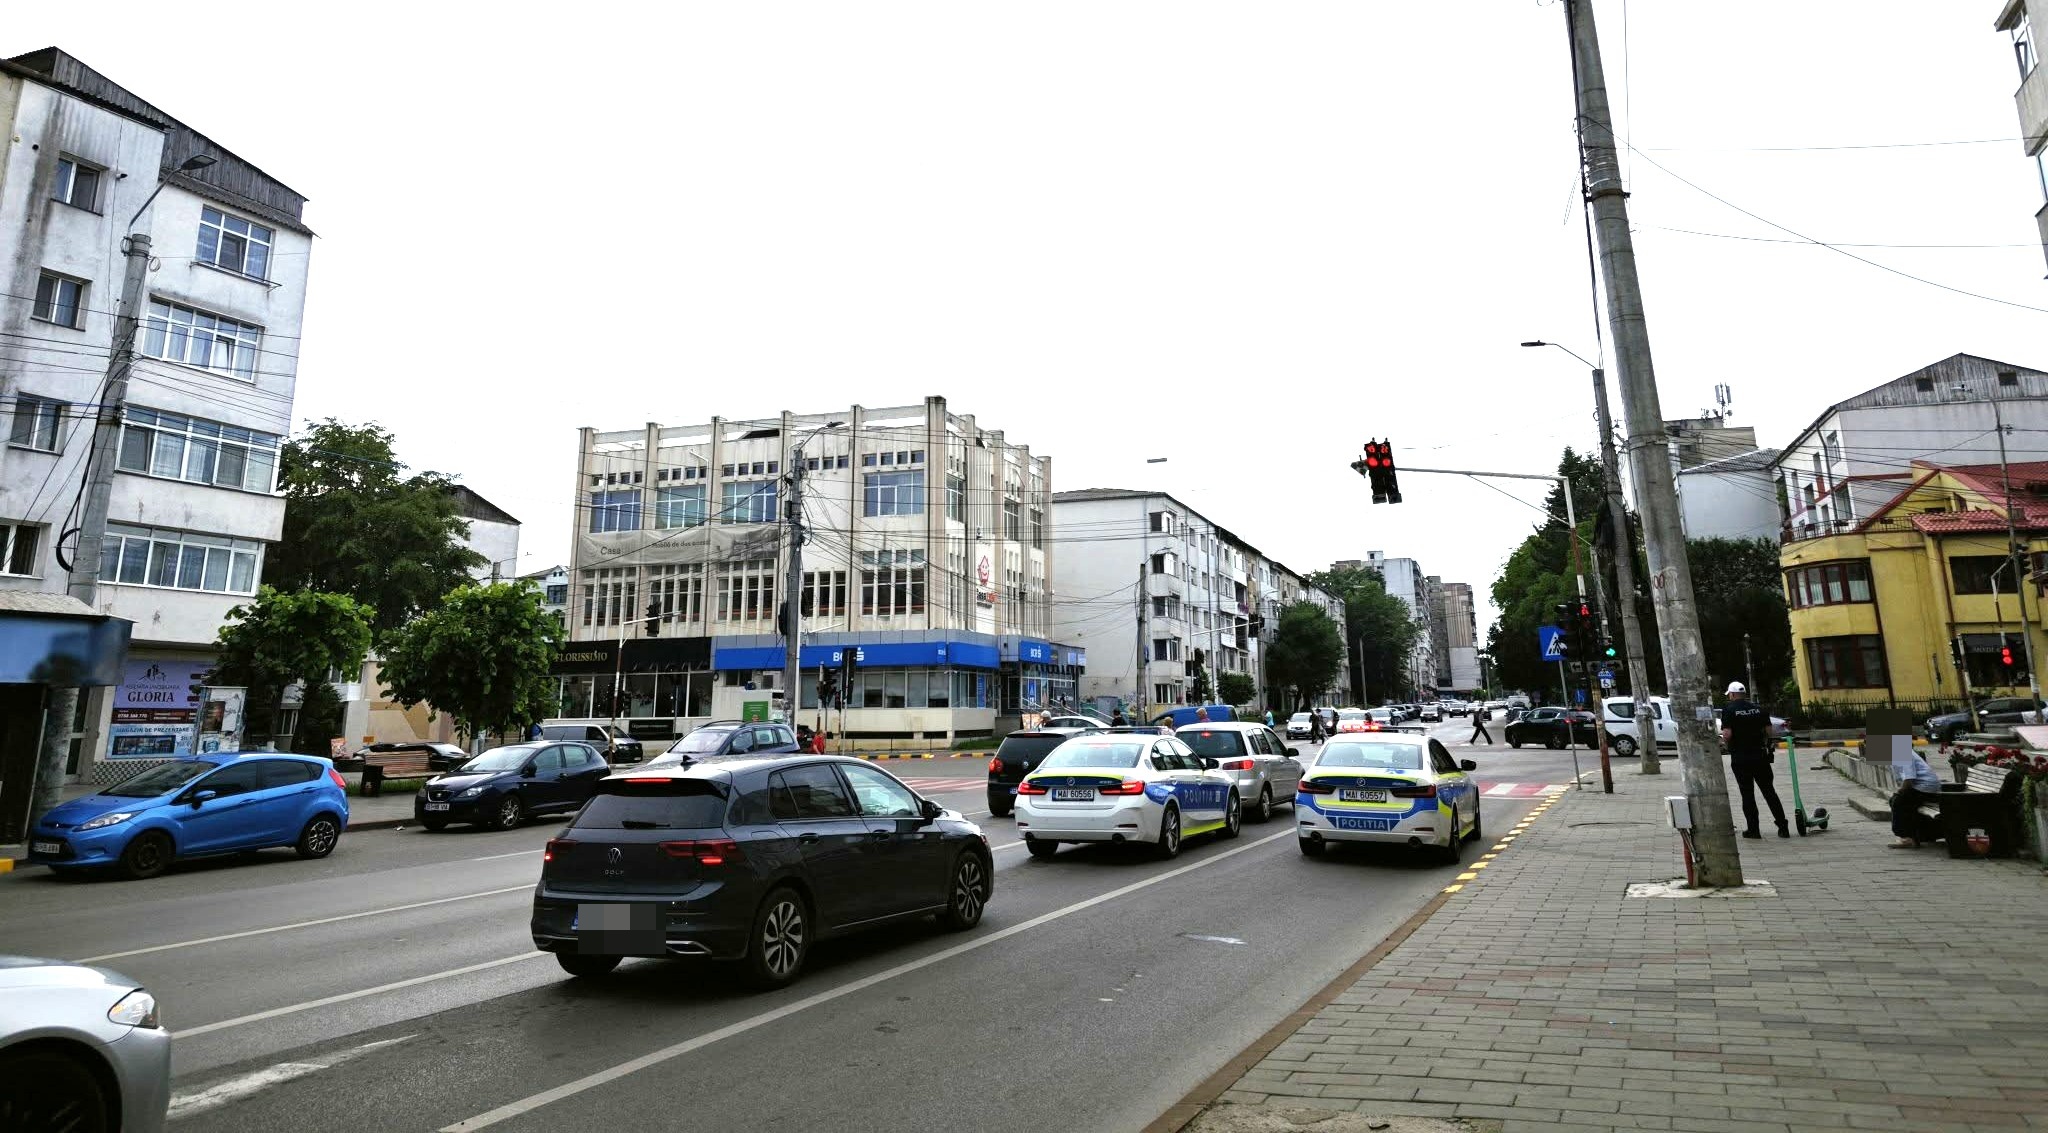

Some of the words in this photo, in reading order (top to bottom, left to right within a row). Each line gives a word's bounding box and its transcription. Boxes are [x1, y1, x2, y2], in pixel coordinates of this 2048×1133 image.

[127, 691, 175, 703] GLORIA
[1057, 789, 1069, 798] MAI
[1070, 789, 1092, 798] 60556
[1346, 790, 1358, 798] MAI
[1360, 791, 1384, 800] 60557
